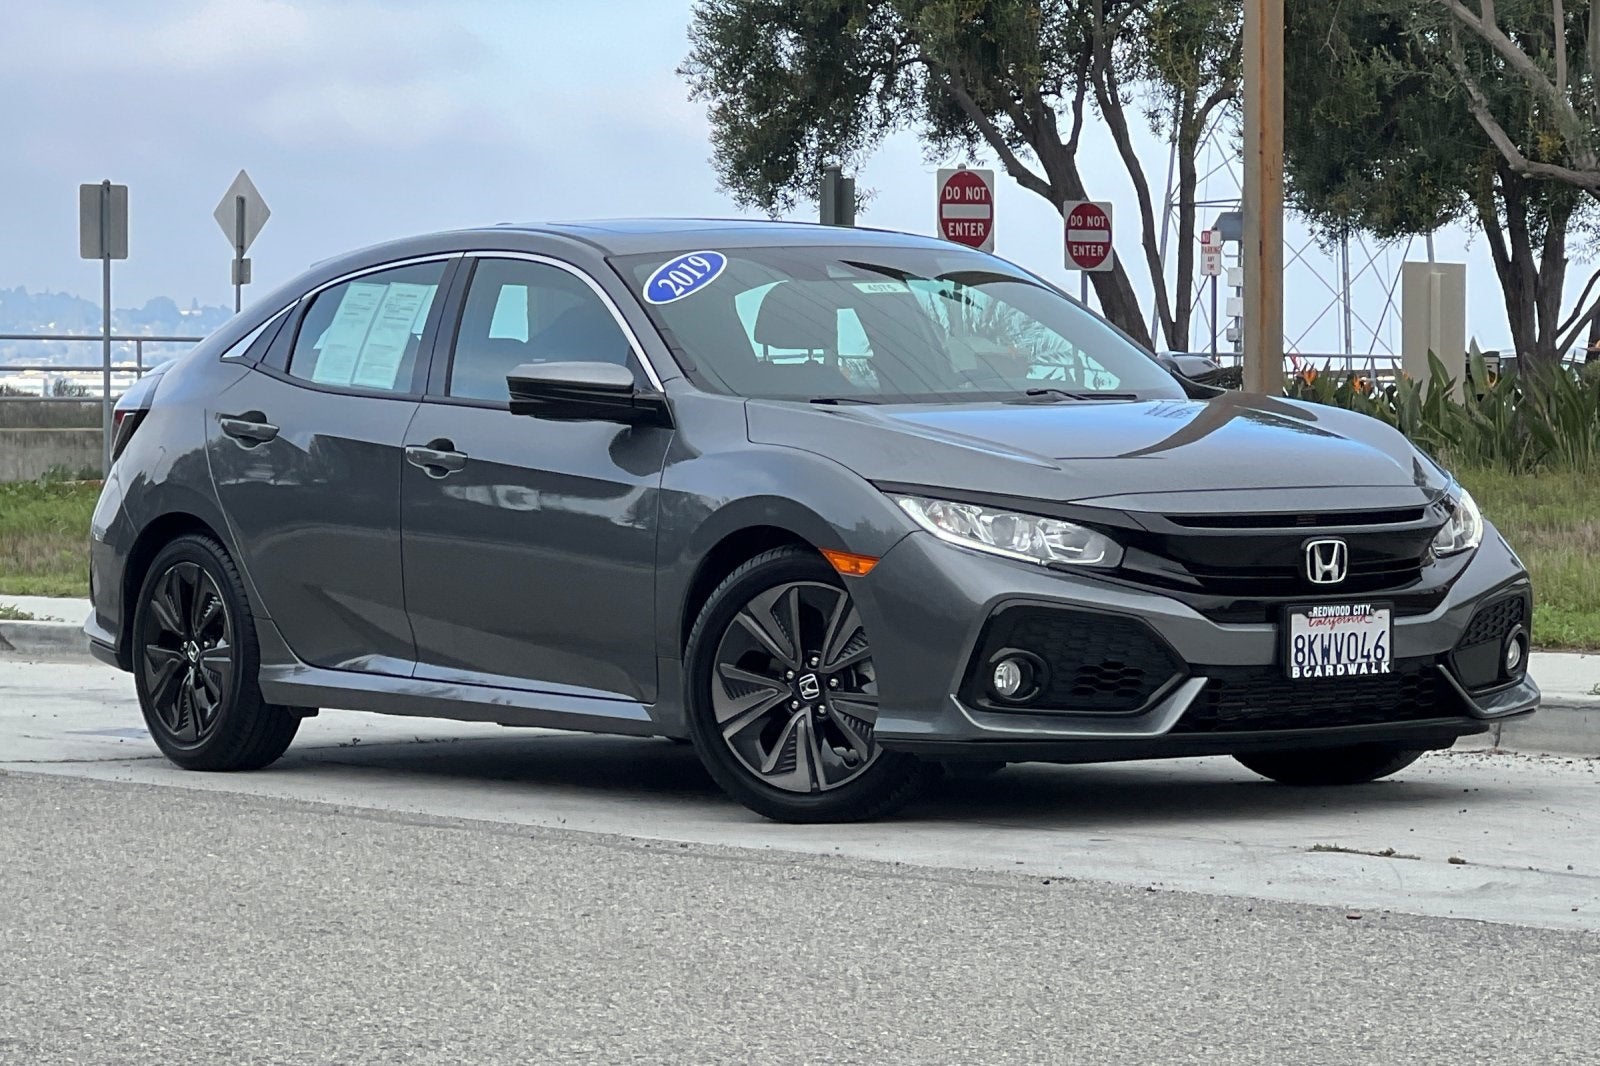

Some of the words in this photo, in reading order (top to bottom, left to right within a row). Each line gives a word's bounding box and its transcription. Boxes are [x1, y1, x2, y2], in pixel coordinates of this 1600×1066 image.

[945, 186, 960, 200] DO
[965, 186, 987, 201] NOT
[1070, 215, 1083, 227] DO
[1086, 215, 1105, 227] NOT
[948, 222, 985, 237] ENTER
[1072, 244, 1104, 257] ENTER
[657, 255, 711, 297] 2019
[1312, 605, 1351, 617] REDWOOD
[1353, 604, 1372, 616] CITY
[1294, 630, 1386, 666] 8KWV046
